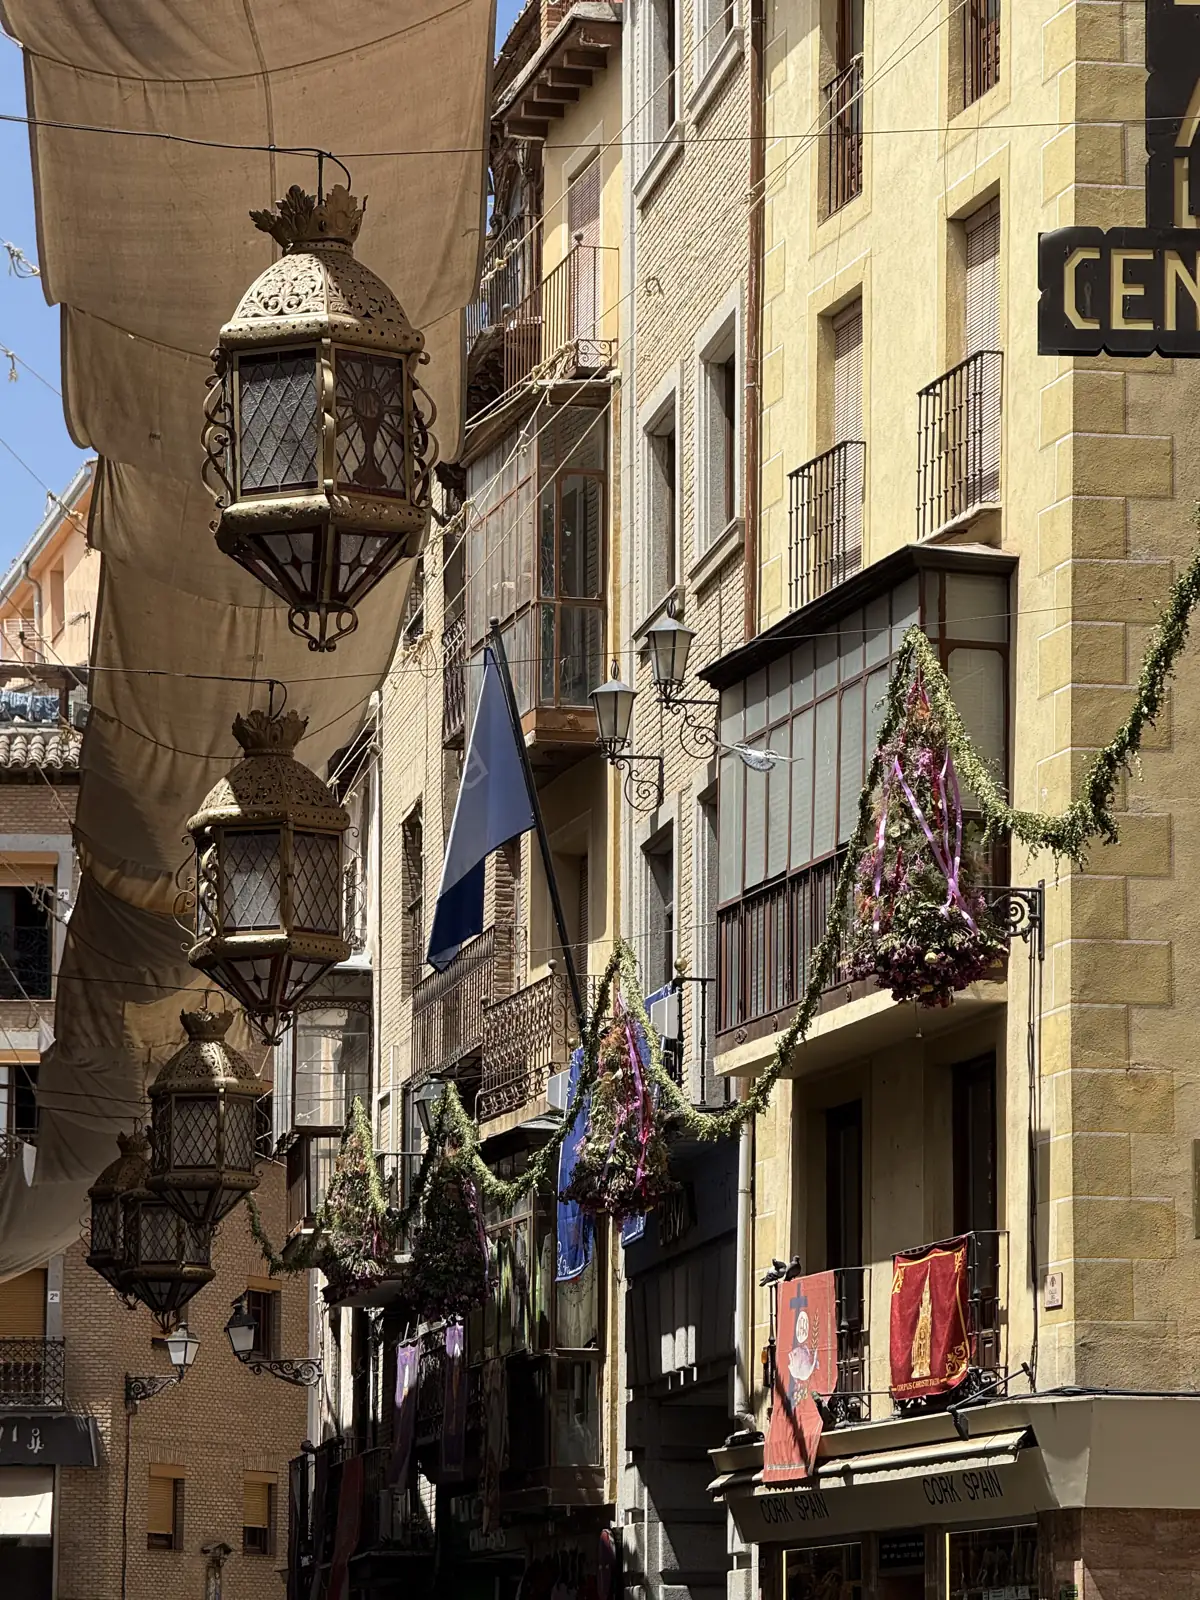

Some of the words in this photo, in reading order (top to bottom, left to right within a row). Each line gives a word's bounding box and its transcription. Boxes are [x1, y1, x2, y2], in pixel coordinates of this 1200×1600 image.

[922, 1474, 962, 1506] CORK
[962, 1469, 1003, 1501] SPAIN
[760, 1496, 794, 1524] CORK
[794, 1492, 830, 1521] SPAIN
